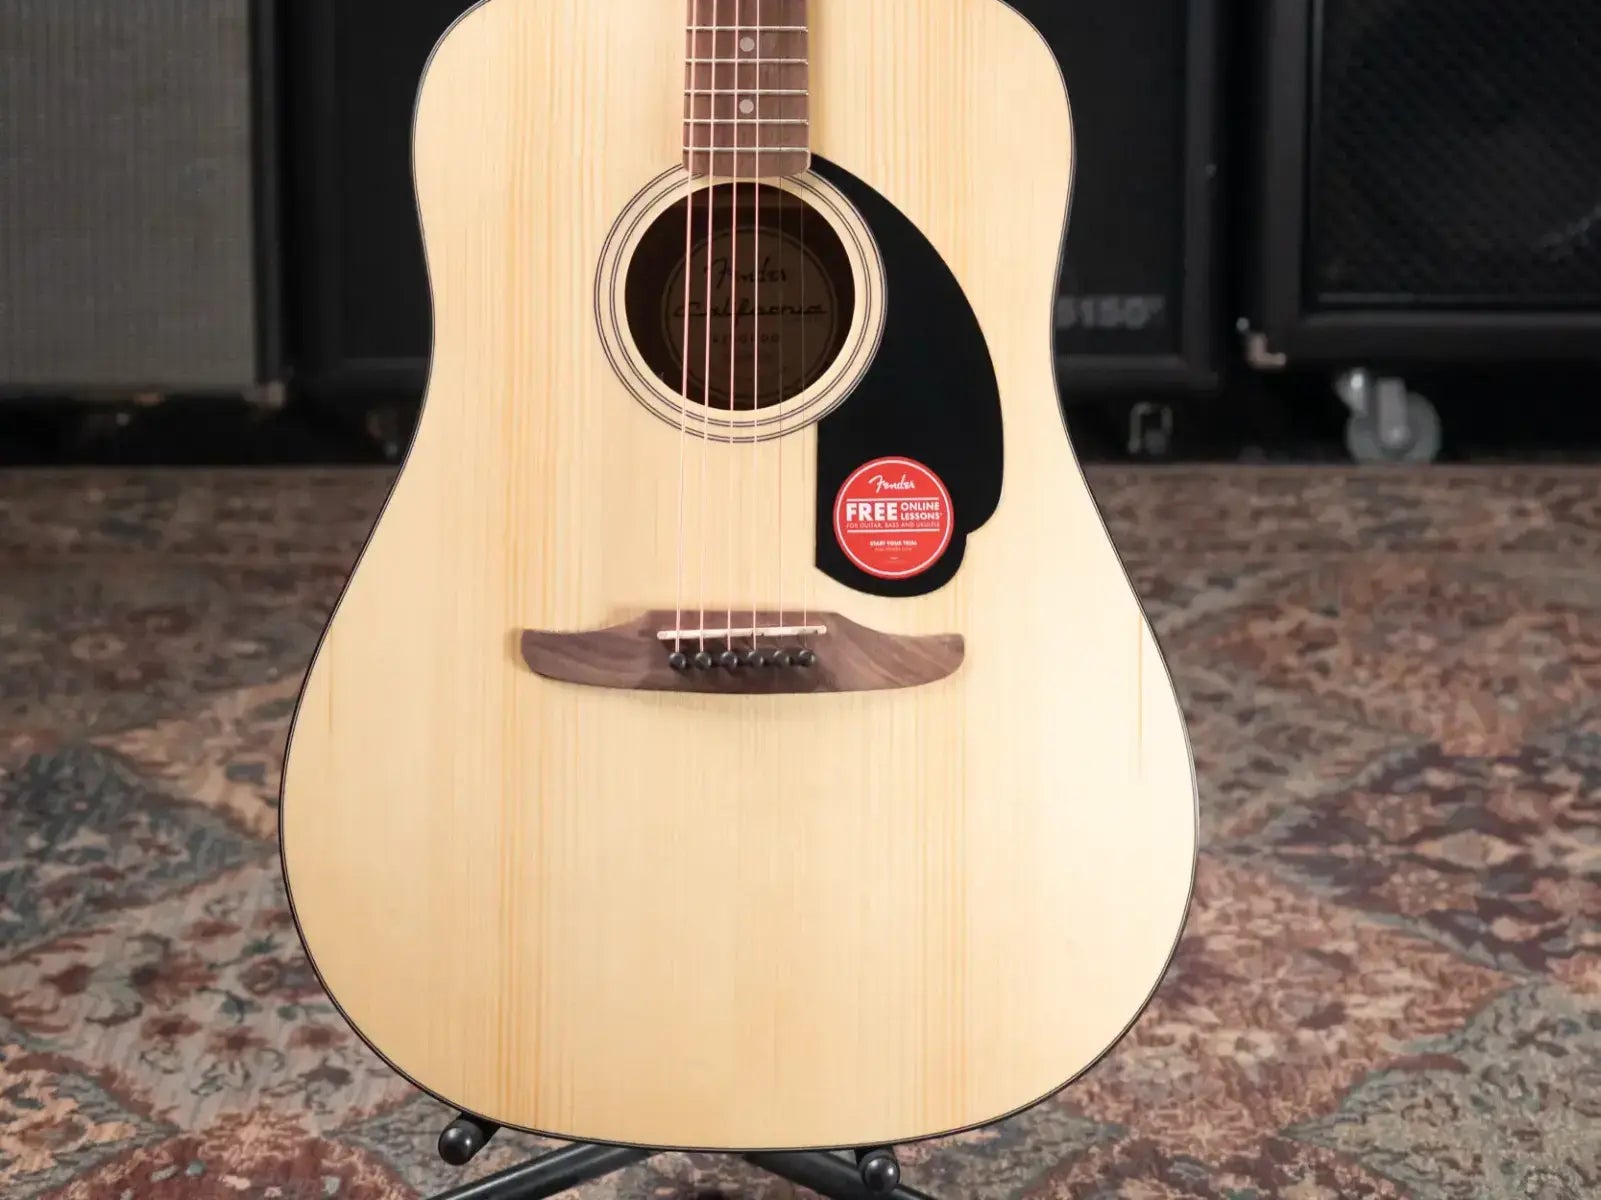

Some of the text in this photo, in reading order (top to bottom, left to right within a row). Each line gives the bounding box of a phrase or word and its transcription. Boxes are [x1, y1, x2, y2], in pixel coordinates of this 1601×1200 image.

[673, 295, 828, 328] Calfornia
[868, 474, 915, 493] Fender
[846, 502, 940, 521] FREE ONLINE
